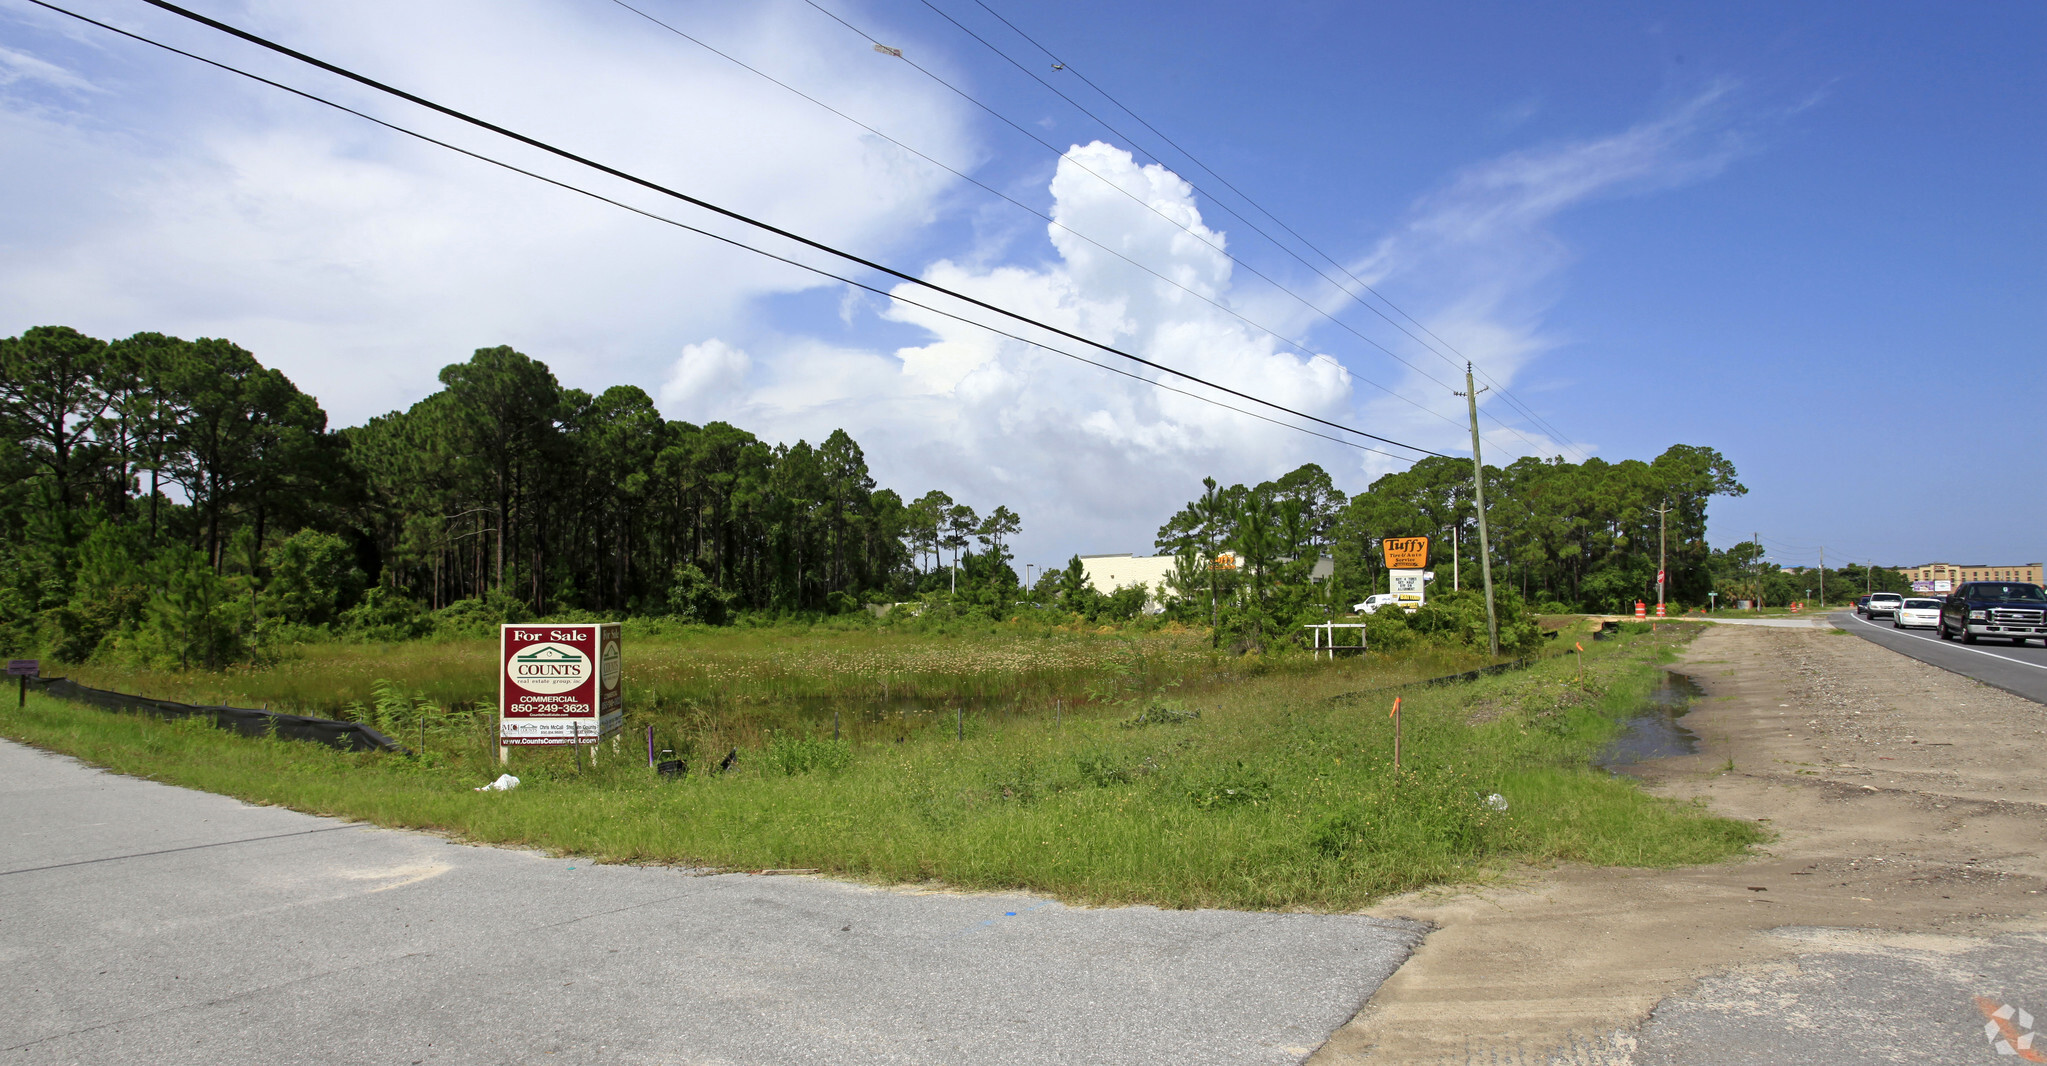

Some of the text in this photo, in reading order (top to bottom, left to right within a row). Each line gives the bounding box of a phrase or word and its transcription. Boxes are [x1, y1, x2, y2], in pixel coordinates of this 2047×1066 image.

[1384, 539, 1425, 553] Tuffy
[513, 630, 587, 641] For Sale
[518, 664, 581, 675] COUNTS
[510, 704, 590, 713] 850-249-3623
